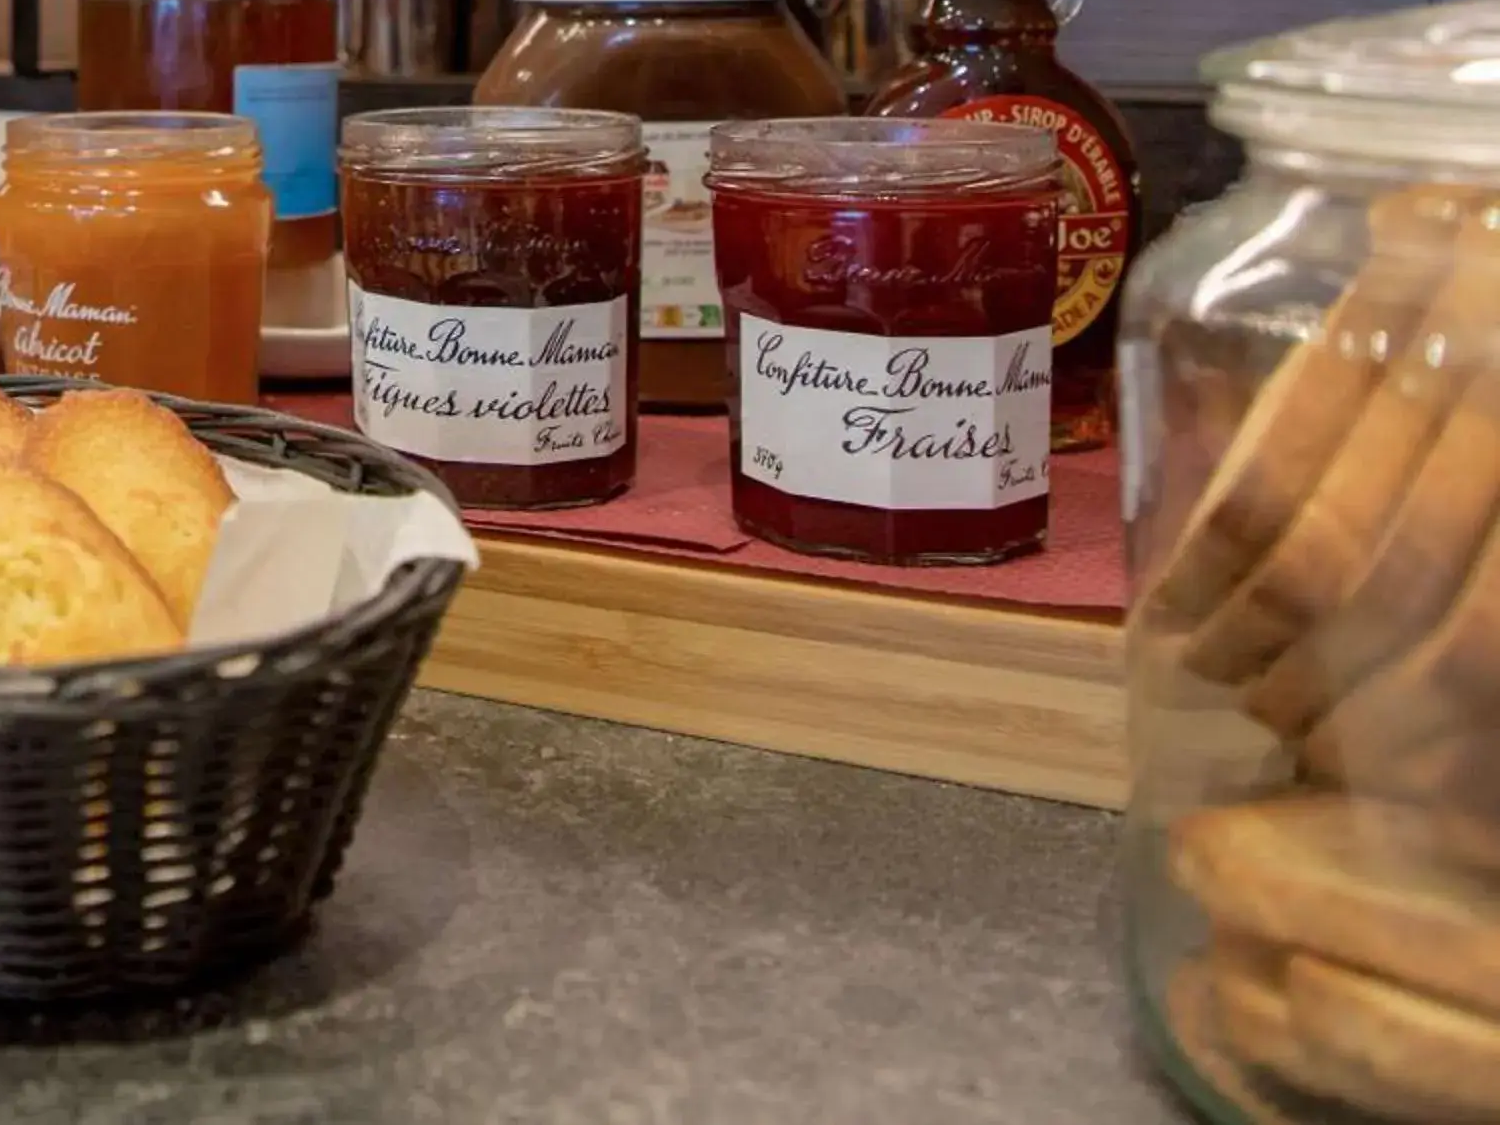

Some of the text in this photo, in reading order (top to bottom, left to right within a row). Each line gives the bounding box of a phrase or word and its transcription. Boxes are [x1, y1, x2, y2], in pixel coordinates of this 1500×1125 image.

[1010, 104, 1068, 130] SIROP
[40, 281, 132, 324] Maman
[426, 318, 524, 367] Bonne
[756, 330, 877, 396] Confiture
[882, 347, 993, 399] Bonne
[467, 380, 611, 421] violettes
[841, 405, 1014, 461] Fraises
